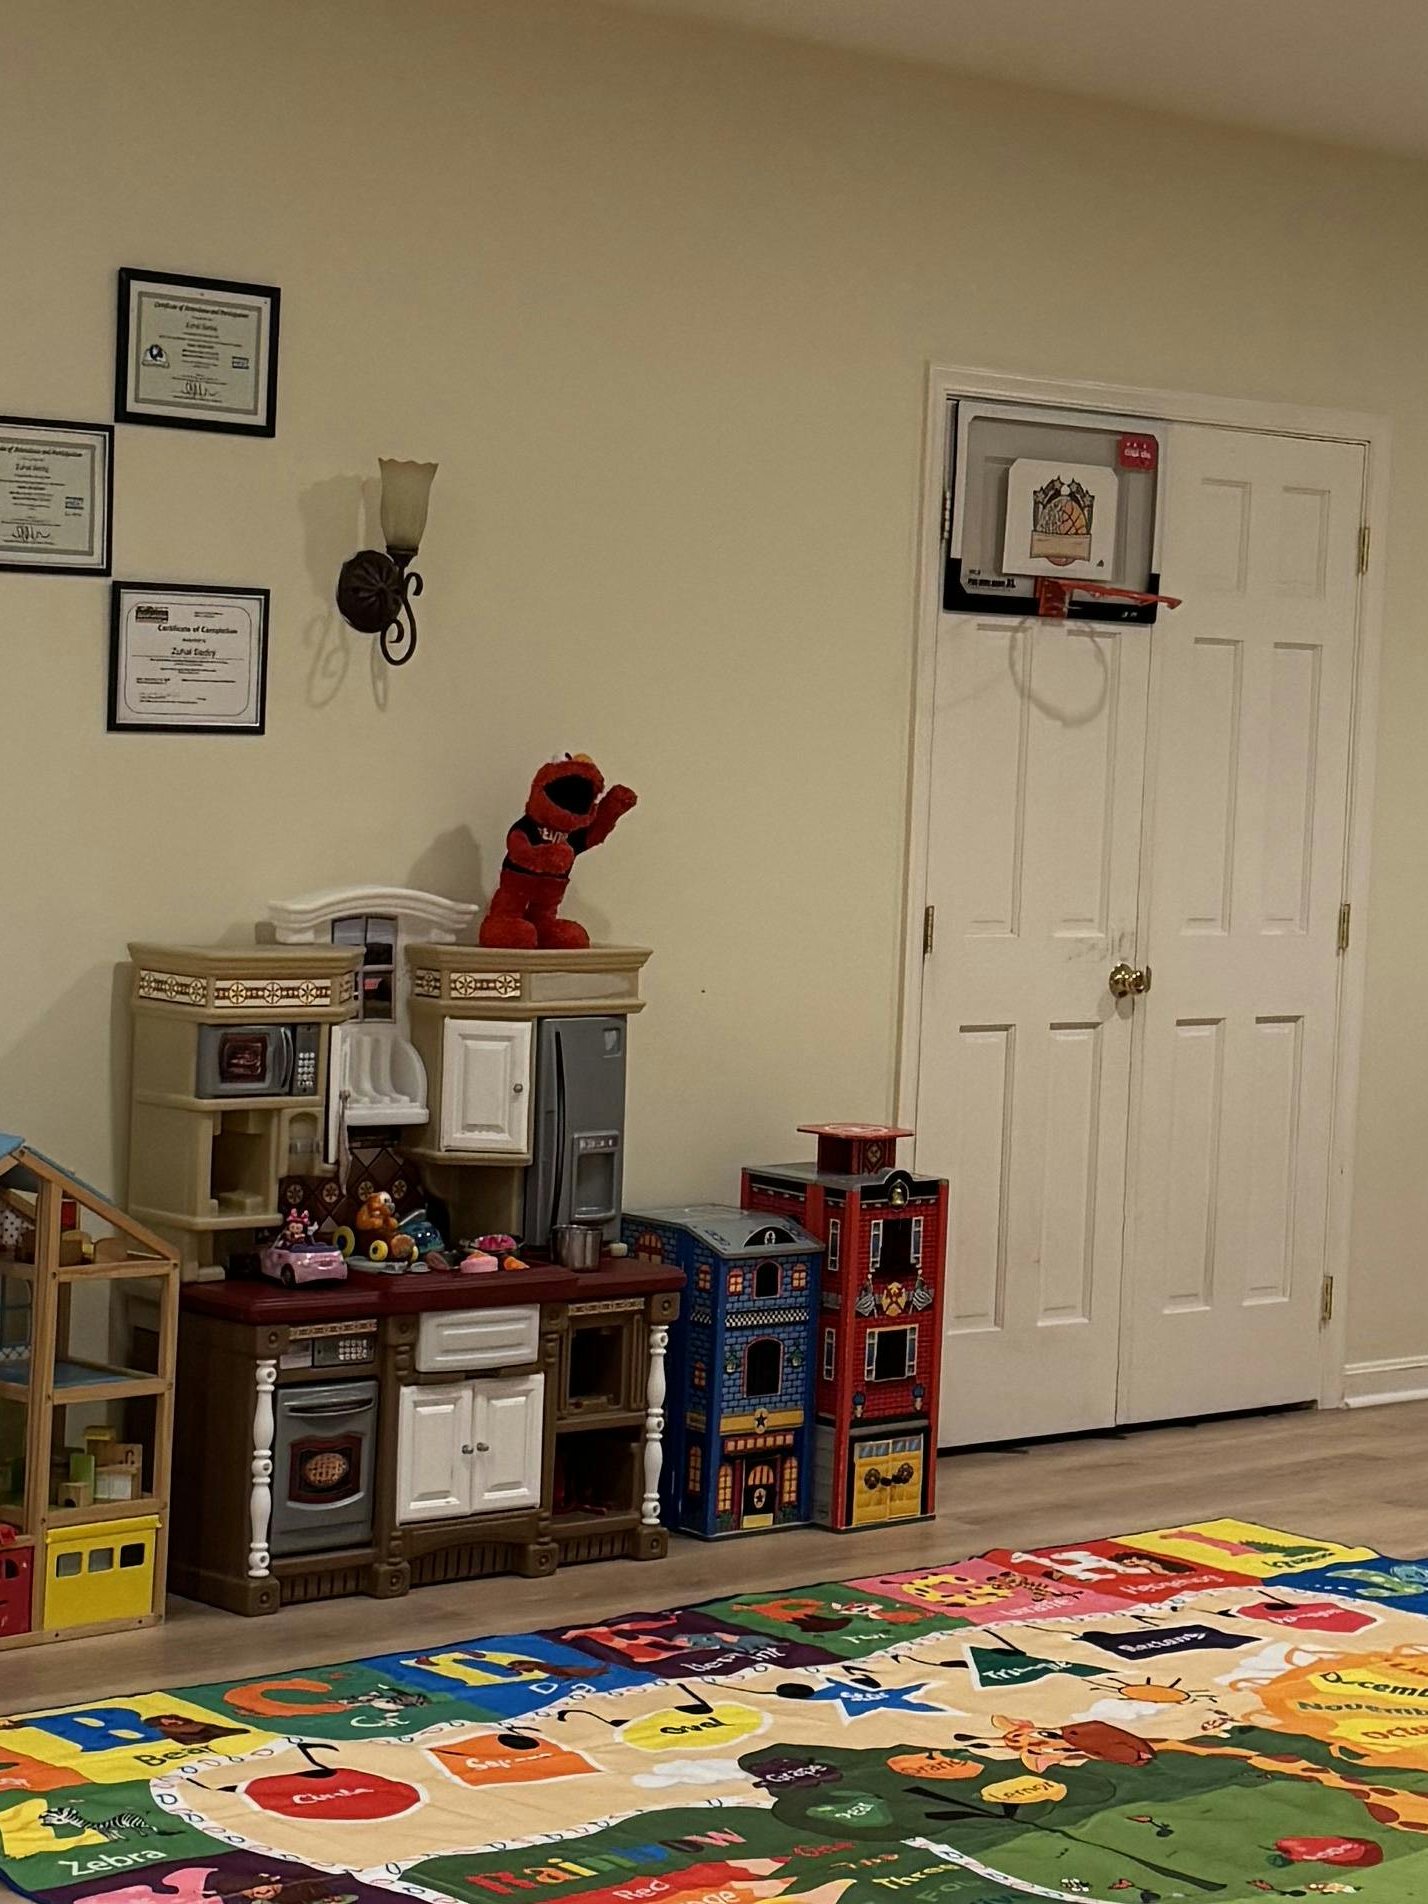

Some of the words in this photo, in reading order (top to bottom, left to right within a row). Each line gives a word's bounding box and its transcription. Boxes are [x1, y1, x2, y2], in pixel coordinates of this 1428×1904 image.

[400, 1650, 553, 1686] D
[224, 1678, 350, 1718] C
[18, 1708, 159, 1752] B
[133, 1746, 219, 1768] Bear
[58, 1844, 168, 1879] Zebra
[612, 1879, 671, 1901] Red
